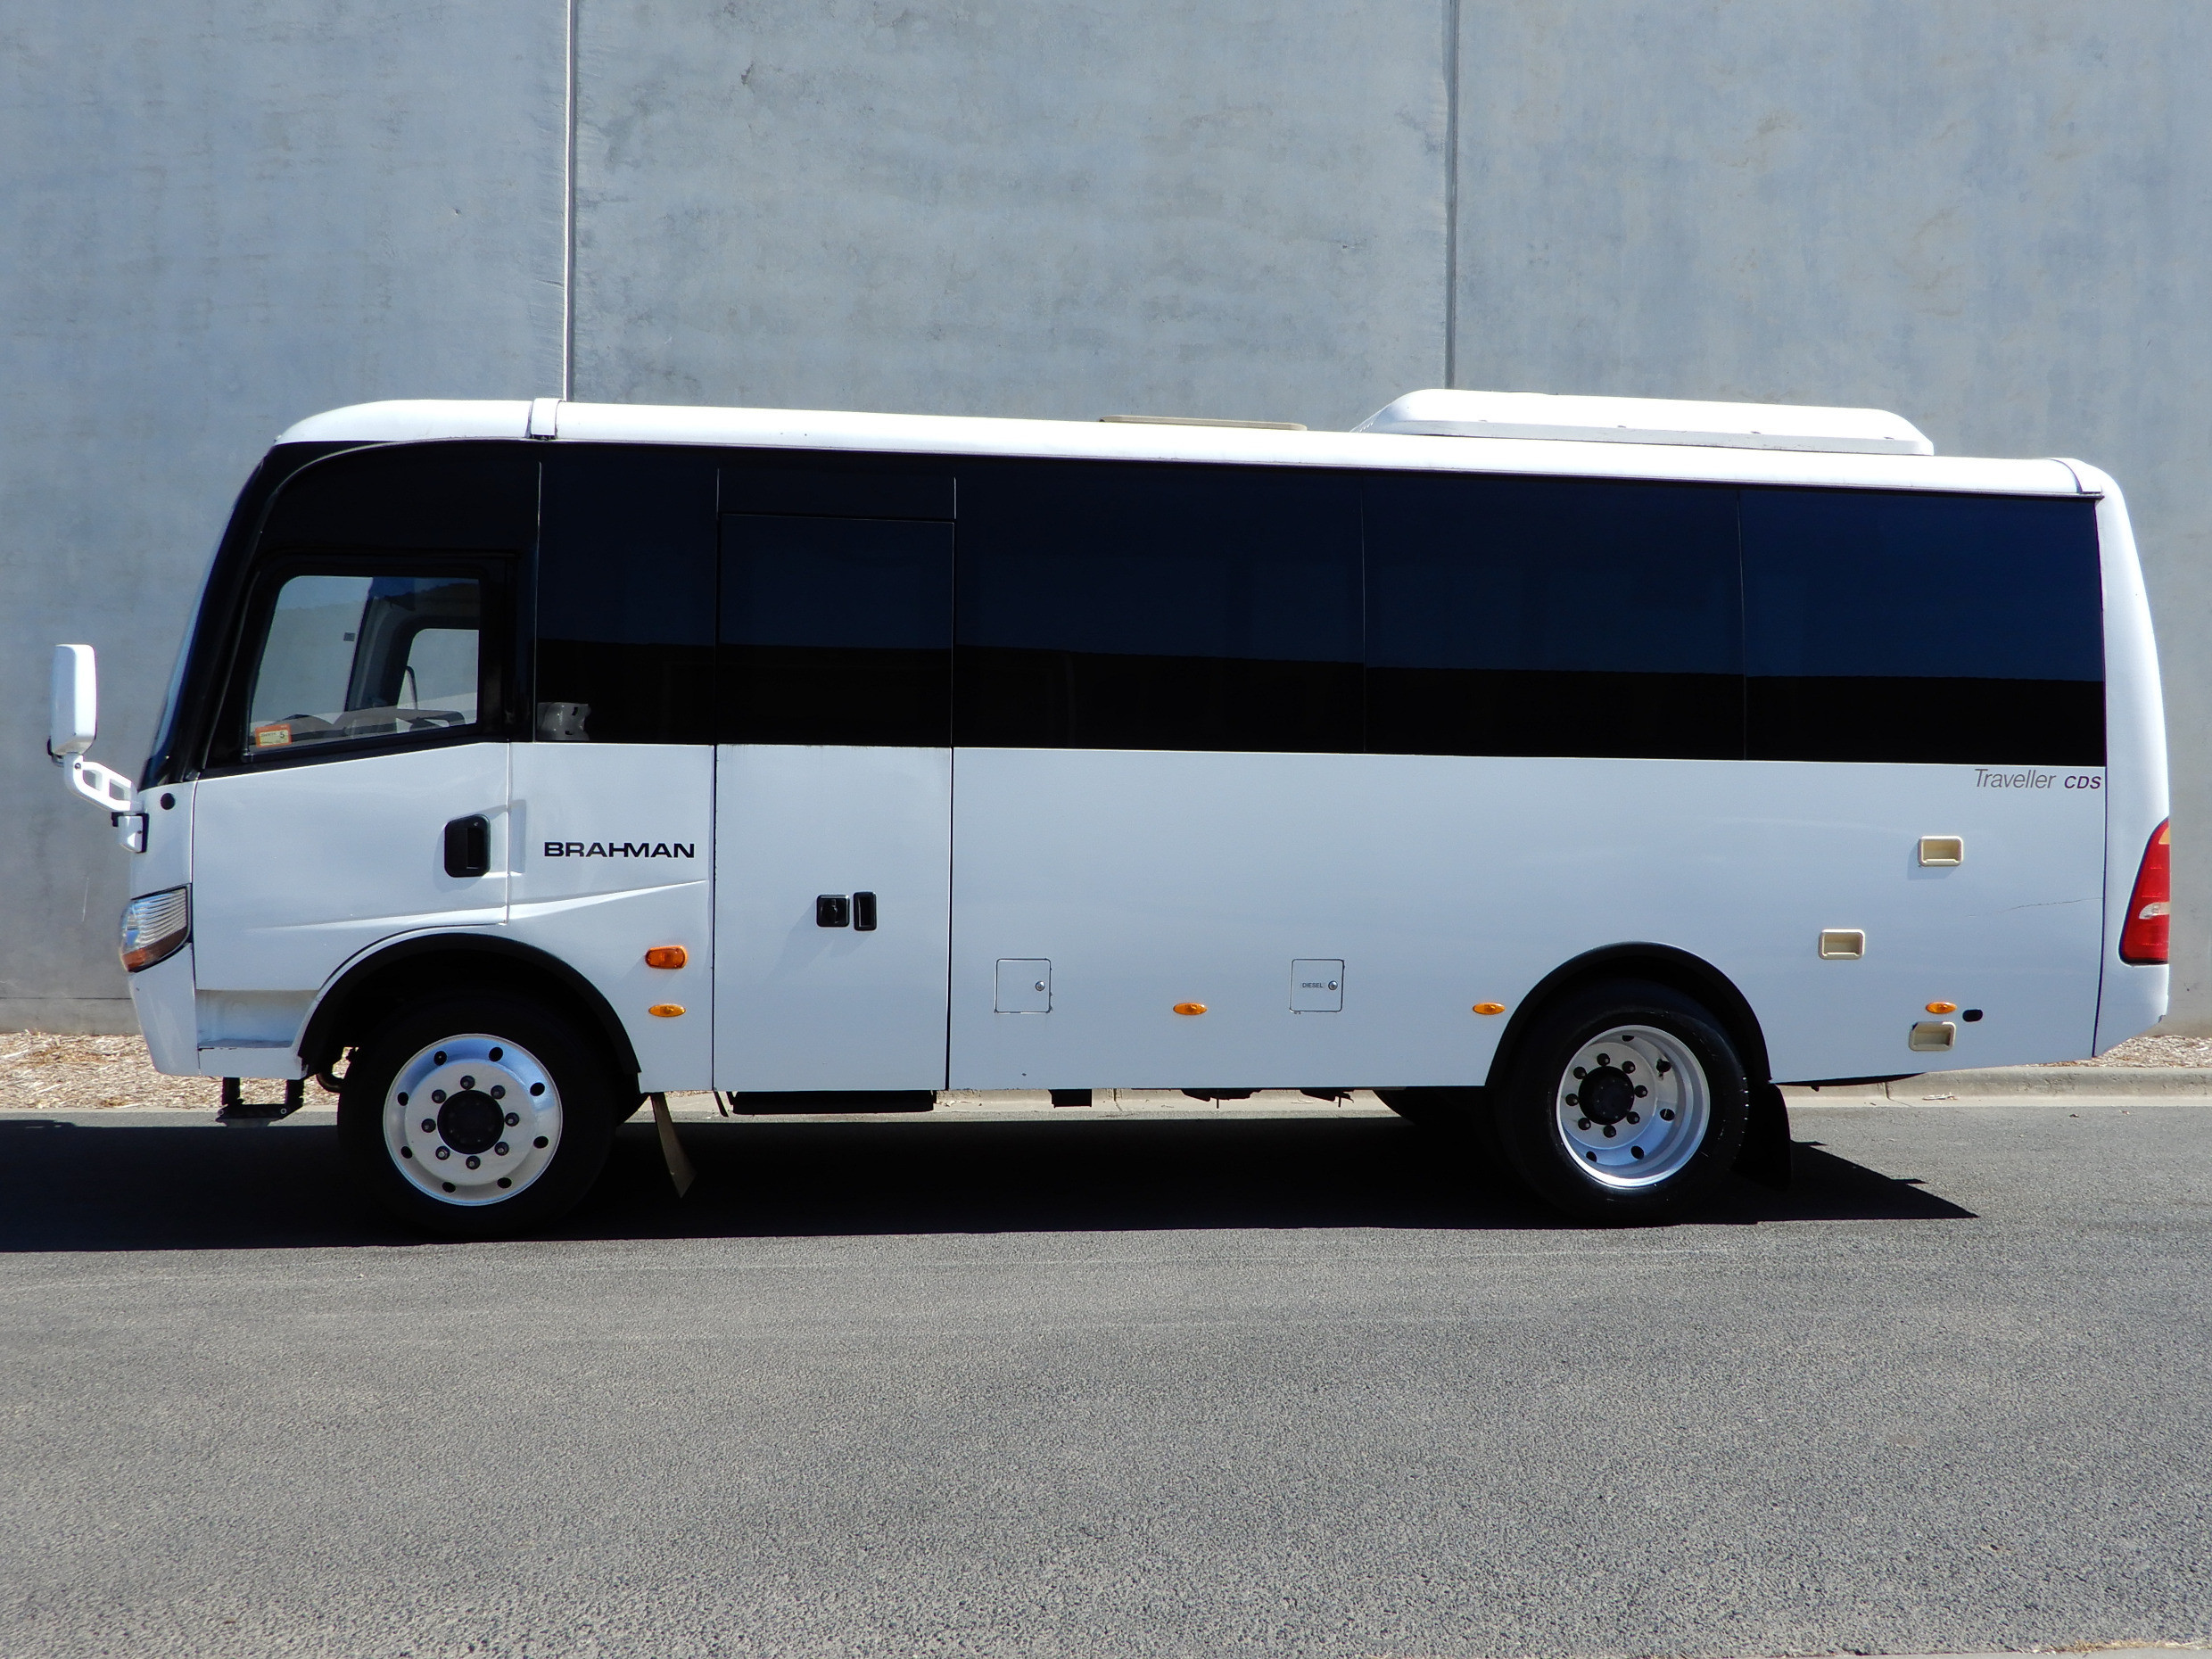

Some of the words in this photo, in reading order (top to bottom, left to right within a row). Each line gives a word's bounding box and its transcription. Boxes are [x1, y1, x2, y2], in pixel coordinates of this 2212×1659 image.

[1974, 768, 2057, 788] Traveller
[2064, 775, 2102, 789] CDS
[544, 841, 695, 858] BRAHMAN
